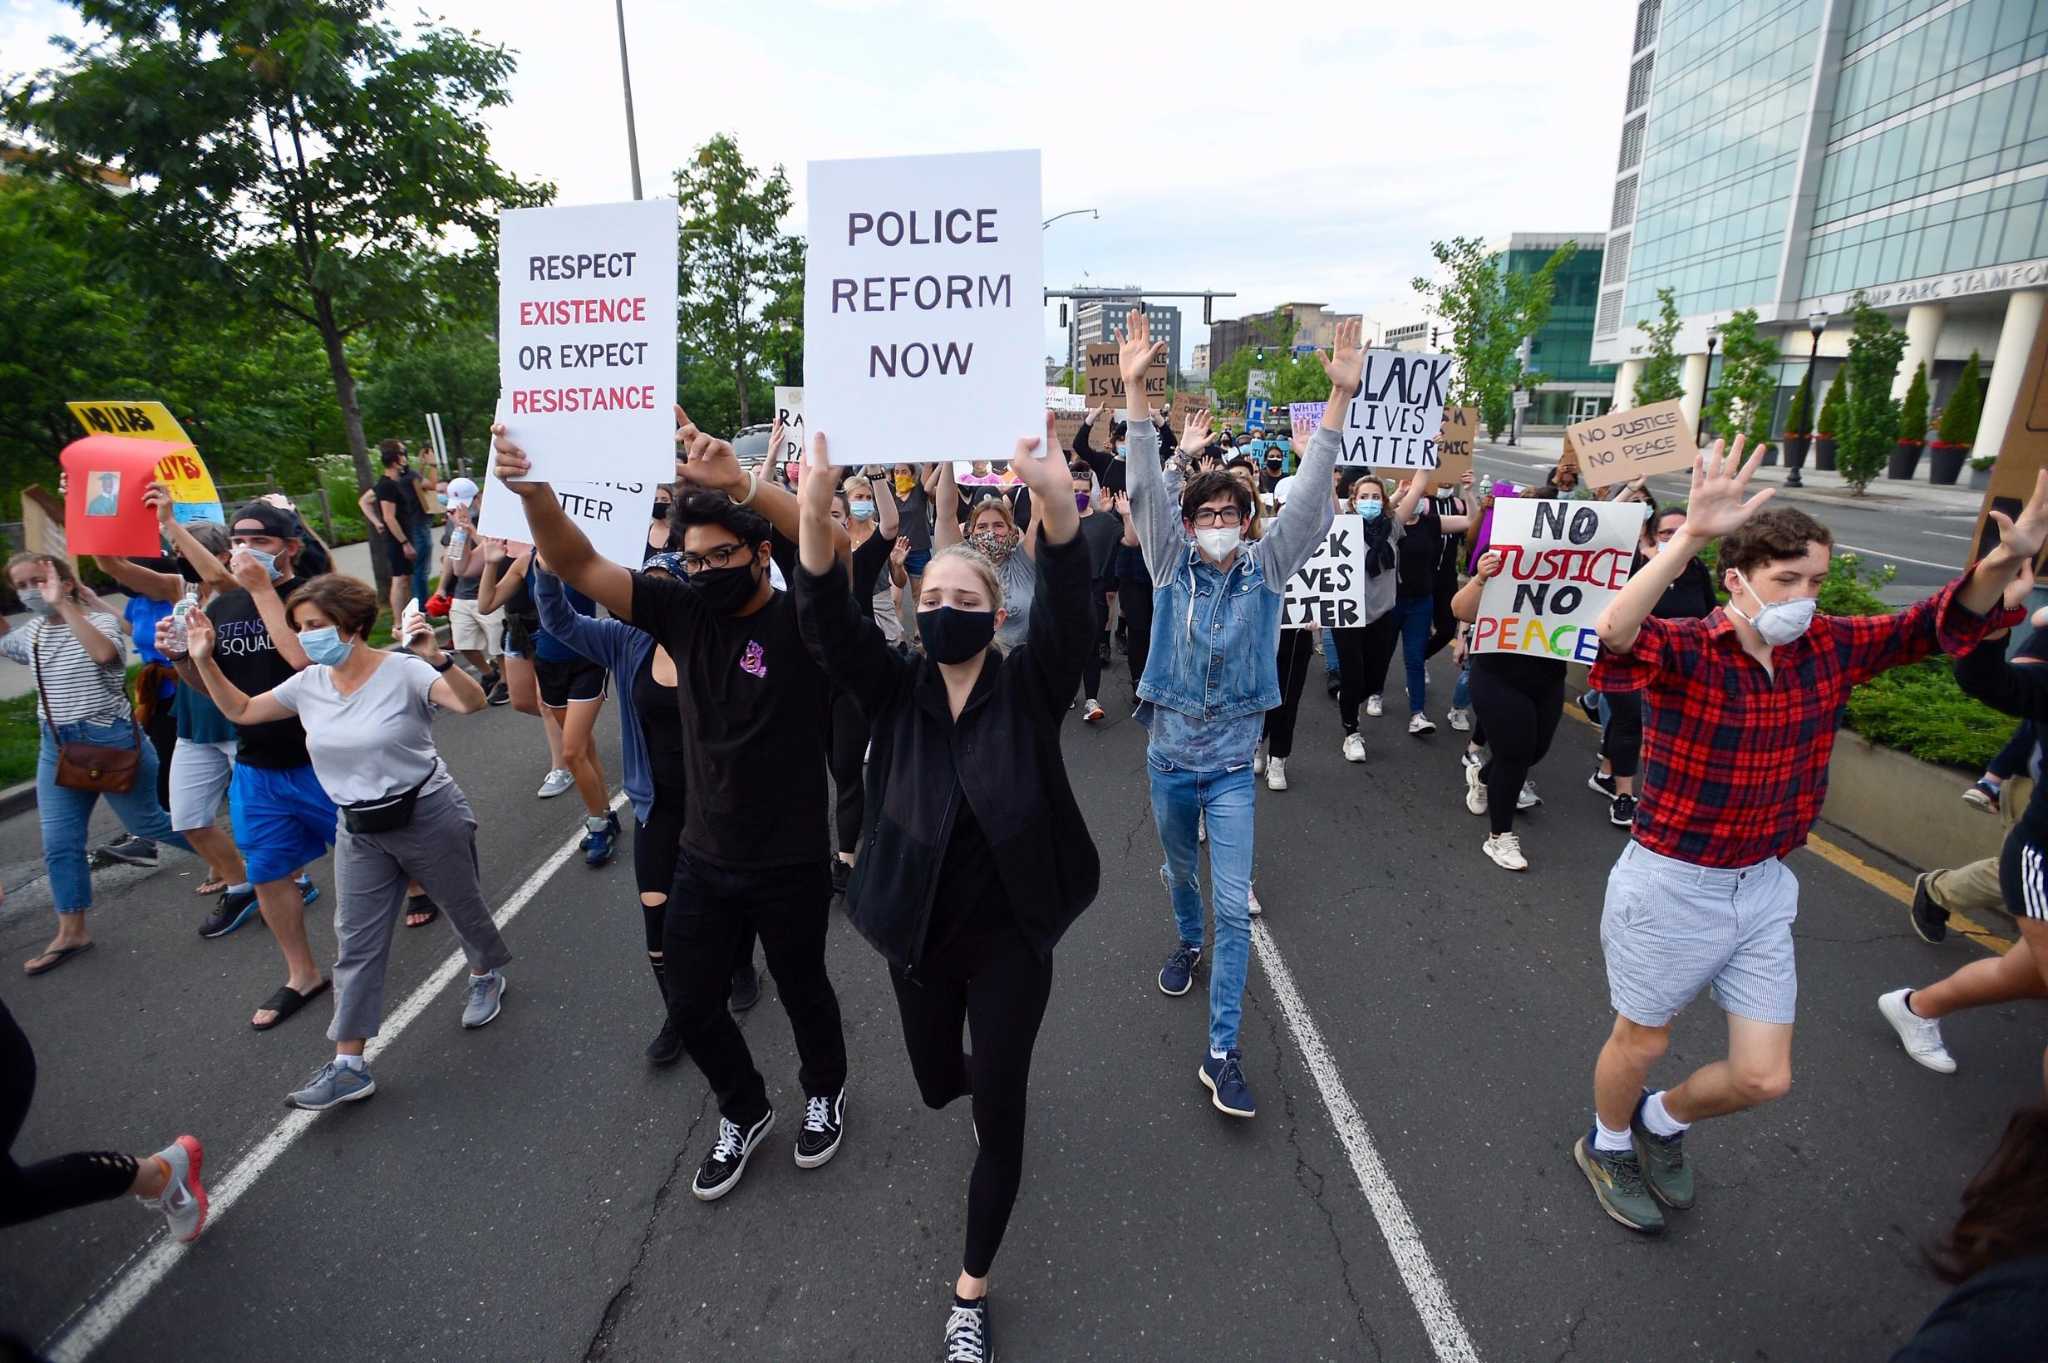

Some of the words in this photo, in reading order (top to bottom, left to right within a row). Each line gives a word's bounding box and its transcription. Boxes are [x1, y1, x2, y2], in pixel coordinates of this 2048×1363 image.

[848, 207, 999, 247] POLICE
[529, 251, 636, 280] RESPECT
[832, 274, 1012, 314] REFORM
[1896, 280, 1943, 302] PARC
[1951, 263, 2048, 294] STAMFO
[520, 297, 646, 326] EXISTENCE
[519, 346, 552, 370] OR
[560, 342, 648, 368] EXPECT
[869, 342, 974, 378] NOW
[1089, 353, 1120, 367] WHIT
[512, 385, 655, 414] RESISTANCE
[1089, 377, 1108, 397] IS
[1111, 377, 1165, 394] VINCE
[1350, 402, 1426, 434] LIVES
[1577, 427, 1606, 447] NO
[1611, 412, 1678, 438] JUSTICE
[1588, 451, 1615, 469] NO
[1622, 436, 1677, 458] PEACE
[558, 492, 614, 522] TTER
[1531, 501, 1600, 546] NO
[1488, 544, 1633, 591] JUSTICE
[1512, 583, 1584, 616] NO
[1473, 616, 1600, 663] PEACE
